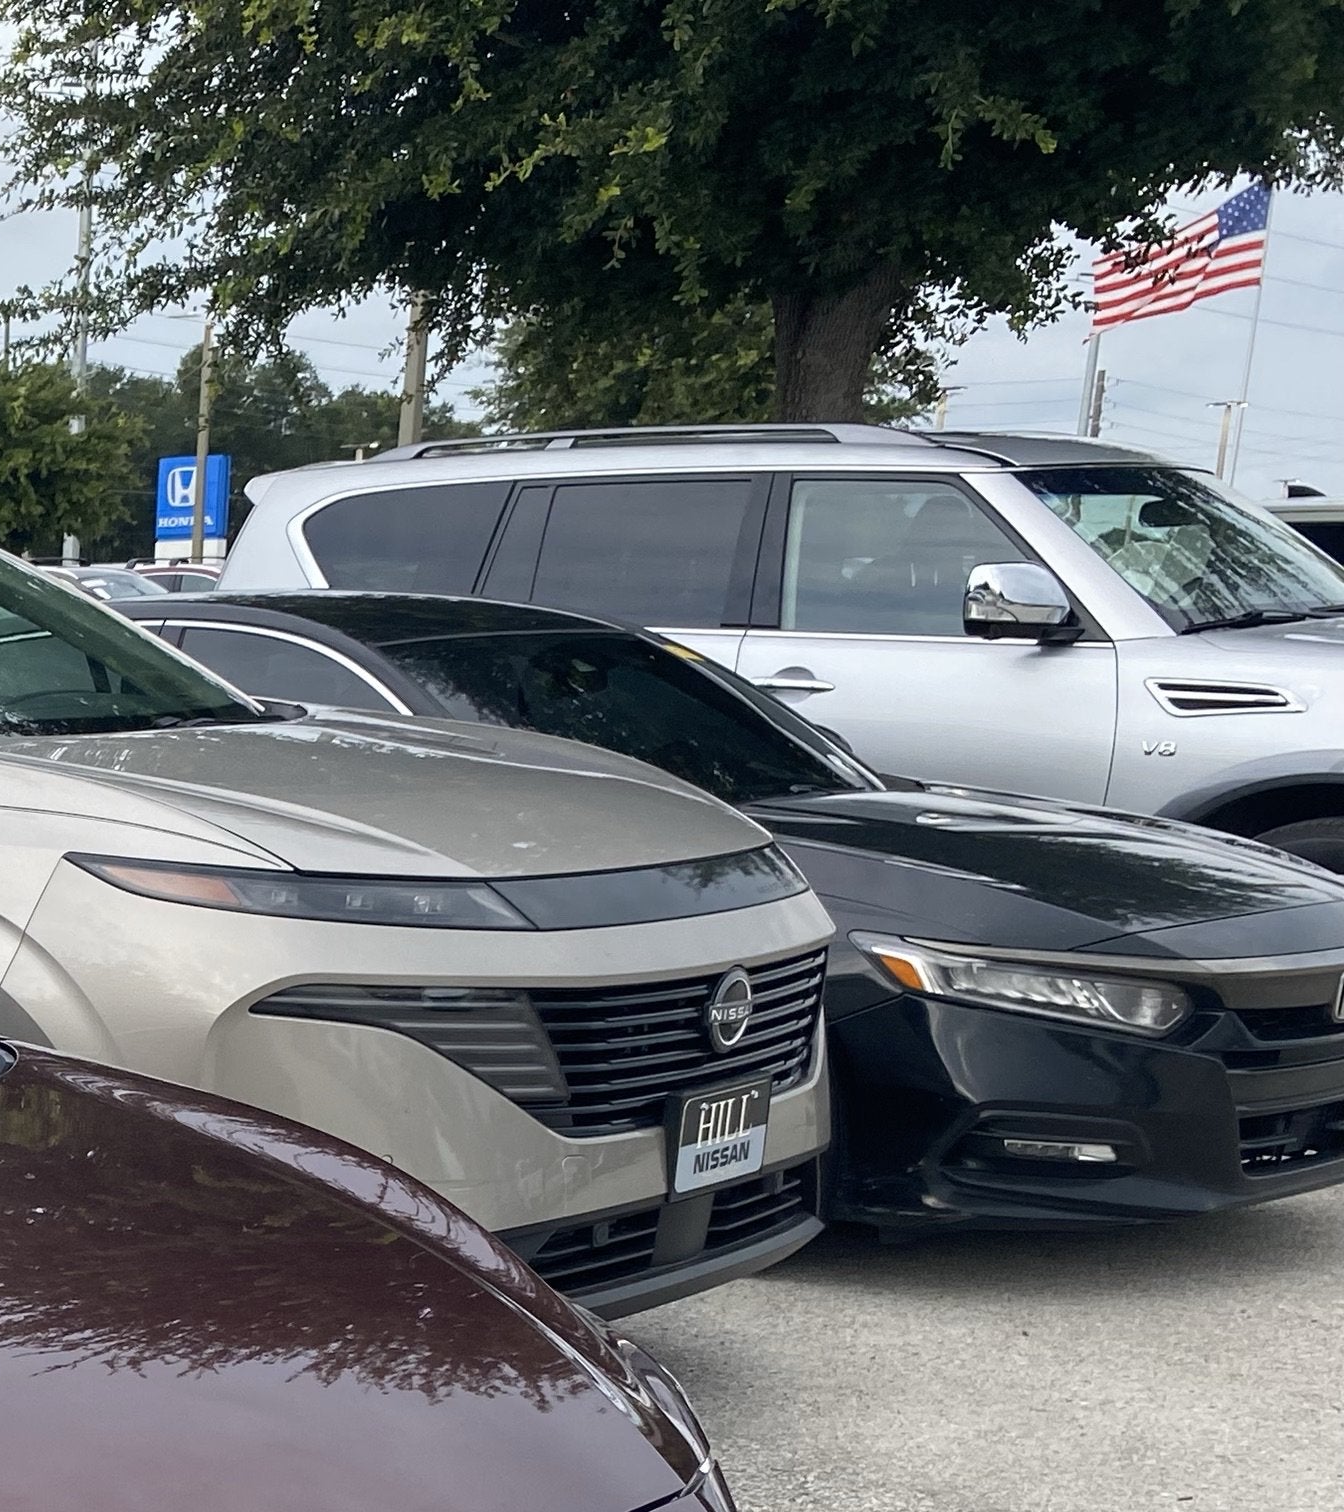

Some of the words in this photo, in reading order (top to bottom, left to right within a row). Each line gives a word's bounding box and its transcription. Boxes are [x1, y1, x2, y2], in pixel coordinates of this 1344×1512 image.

[158, 515, 214, 527] HONA
[1141, 740, 1177, 756] V8
[711, 1003, 750, 1021] NISS
[696, 1093, 752, 1150] HILL
[693, 1139, 751, 1175] NISSAN
